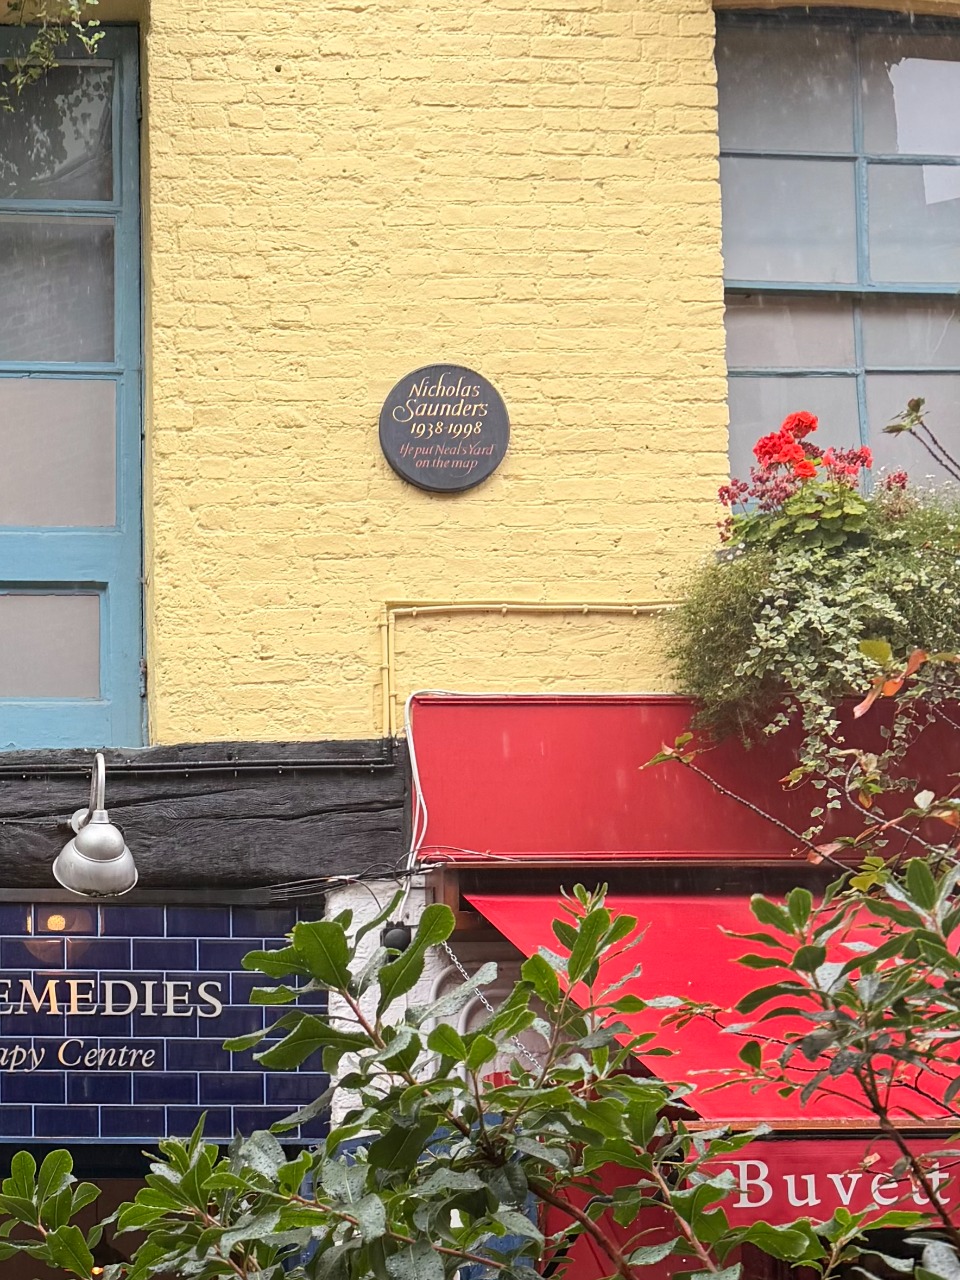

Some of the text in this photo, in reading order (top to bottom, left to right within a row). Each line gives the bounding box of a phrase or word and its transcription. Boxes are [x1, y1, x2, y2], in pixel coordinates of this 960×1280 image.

[408, 371, 481, 398] Nicholas
[392, 398, 489, 423] Saunders
[410, 421, 483, 440] 1938-1998
[413, 444, 434, 460] put
[468, 441, 495, 456] Yard
[415, 456, 478, 478] on the map
[57, 1038, 156, 1068] Centre
